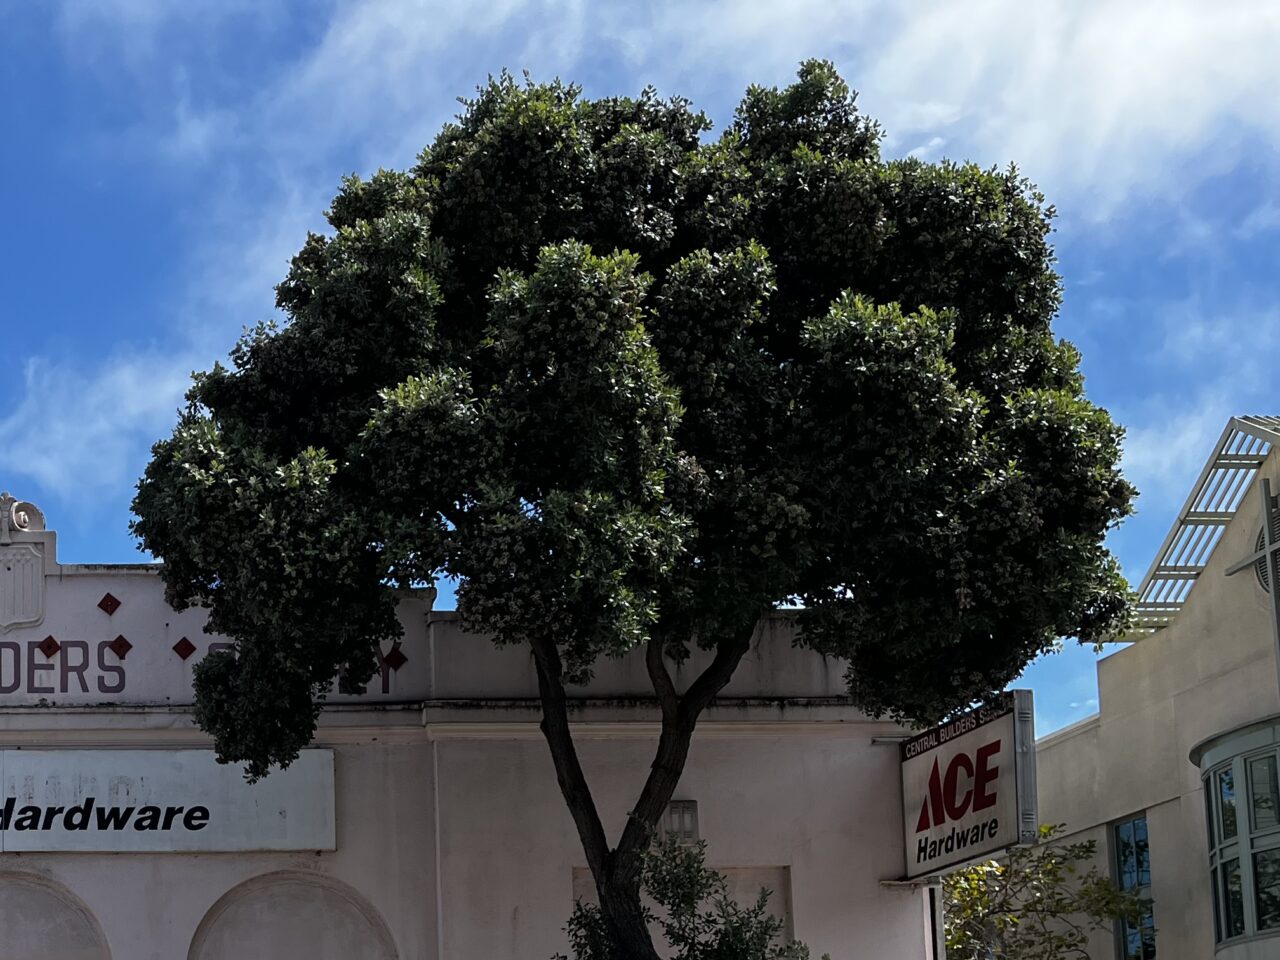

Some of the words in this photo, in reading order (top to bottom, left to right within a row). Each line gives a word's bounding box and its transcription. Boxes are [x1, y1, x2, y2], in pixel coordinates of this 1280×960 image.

[905, 731, 938, 758] CENTRAL
[940, 713, 977, 742] BUILDERS
[915, 739, 1001, 833] ACE
[917, 818, 998, 864] Hardware
